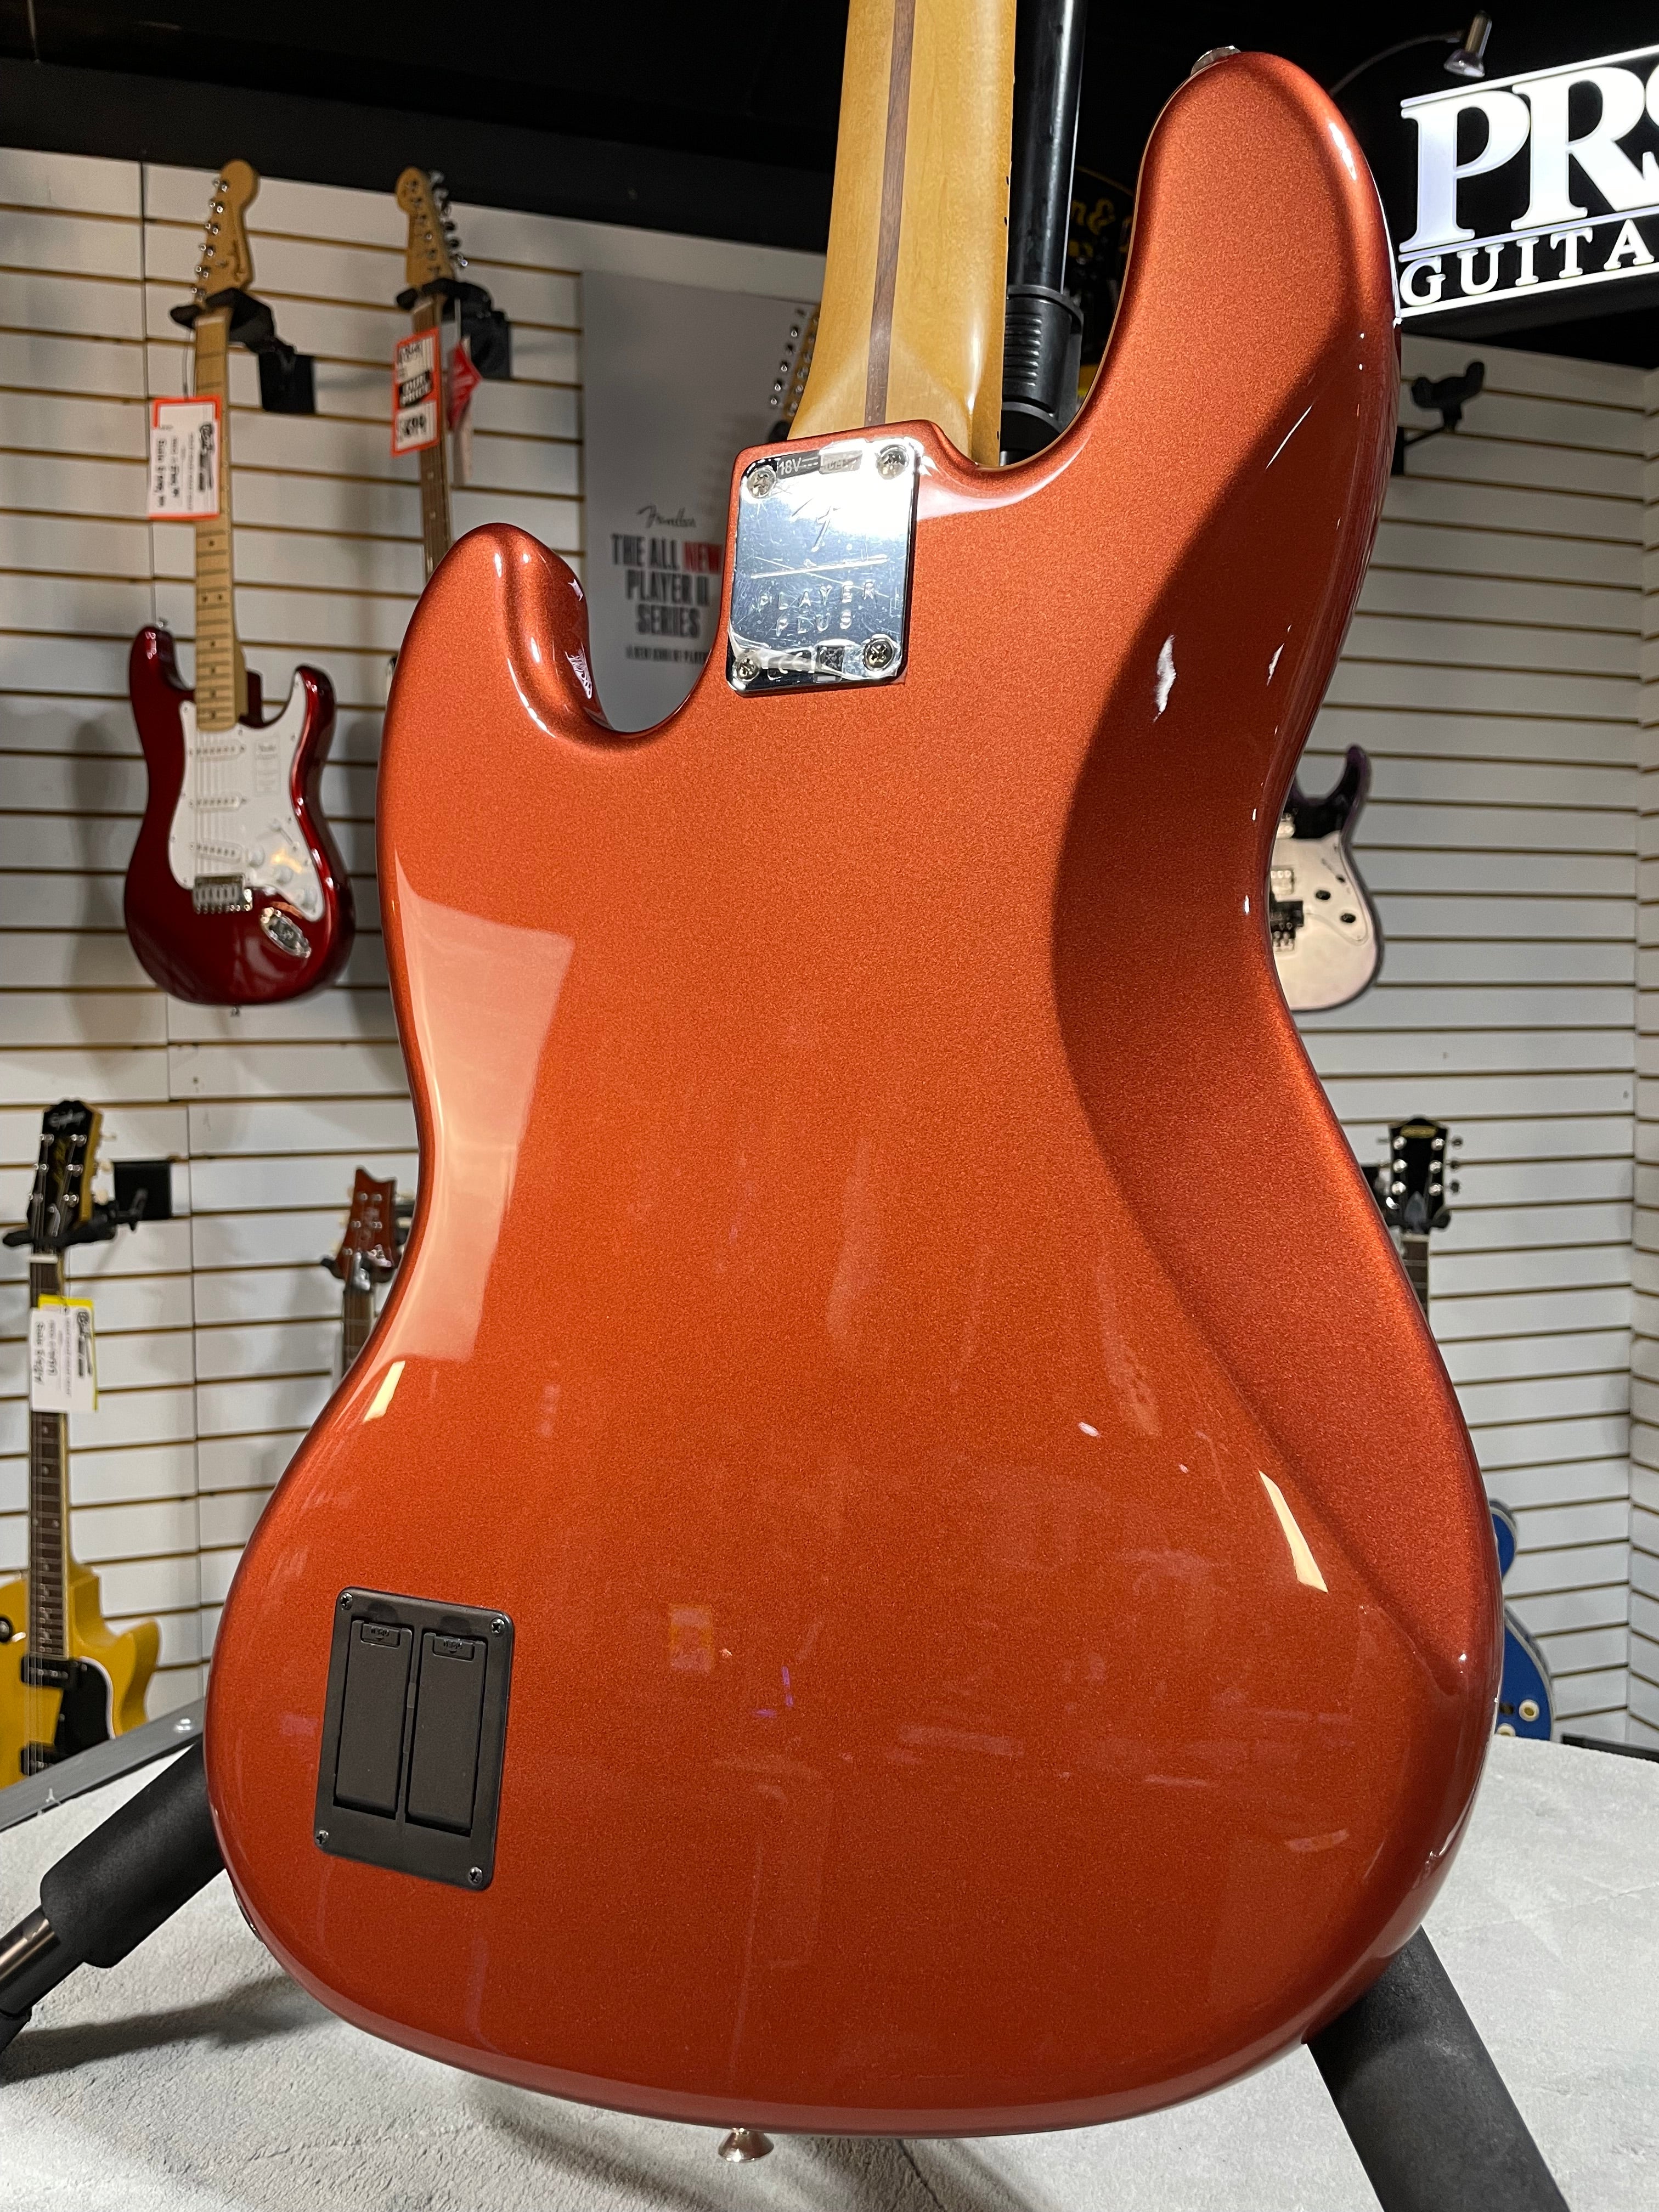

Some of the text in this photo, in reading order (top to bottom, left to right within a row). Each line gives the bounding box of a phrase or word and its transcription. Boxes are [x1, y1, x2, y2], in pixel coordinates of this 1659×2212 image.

[1400, 63, 1659, 252] PR
[1400, 219, 1655, 307] GUITA
[778, 457, 802, 476] 18V
[611, 533, 721, 573] THE ALL NEW
[626, 569, 692, 604] PLAYER
[759, 579, 875, 612] PLAYER
[637, 604, 700, 638] SERIES
[776, 610, 852, 637] PLUS
